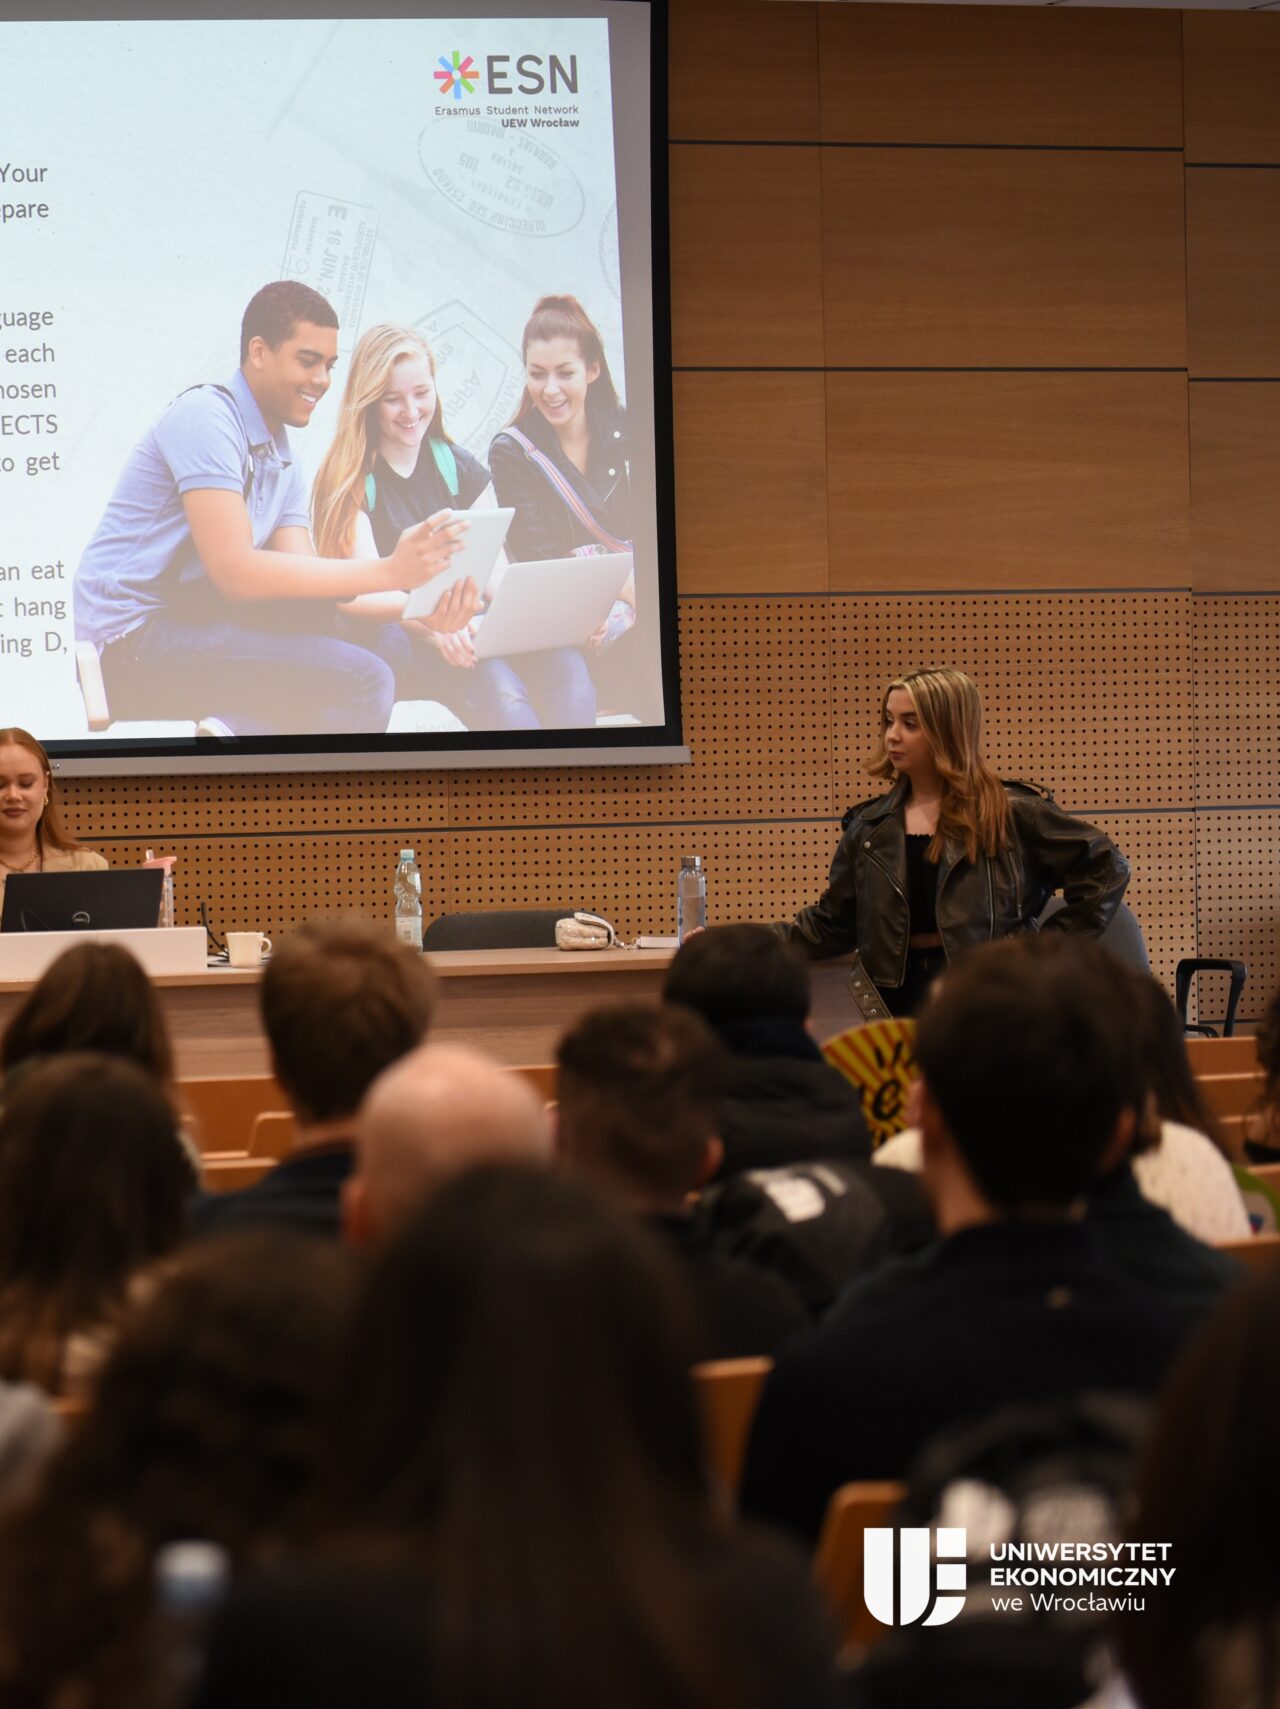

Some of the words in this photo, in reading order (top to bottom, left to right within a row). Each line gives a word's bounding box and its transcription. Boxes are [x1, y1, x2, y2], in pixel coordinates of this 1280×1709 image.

[486, 54, 579, 95] ESN
[434, 105, 481, 116] Erasmus
[486, 105, 529, 115] Student
[534, 104, 579, 115] Network
[501, 118, 528, 128] UEW
[530, 117, 580, 128] Wrocław
[2, 342, 56, 364] each
[0, 413, 59, 436] ECTS
[25, 451, 61, 477] get
[30, 559, 65, 581] eat
[13, 596, 67, 621] hang
[44, 631, 68, 655] D,
